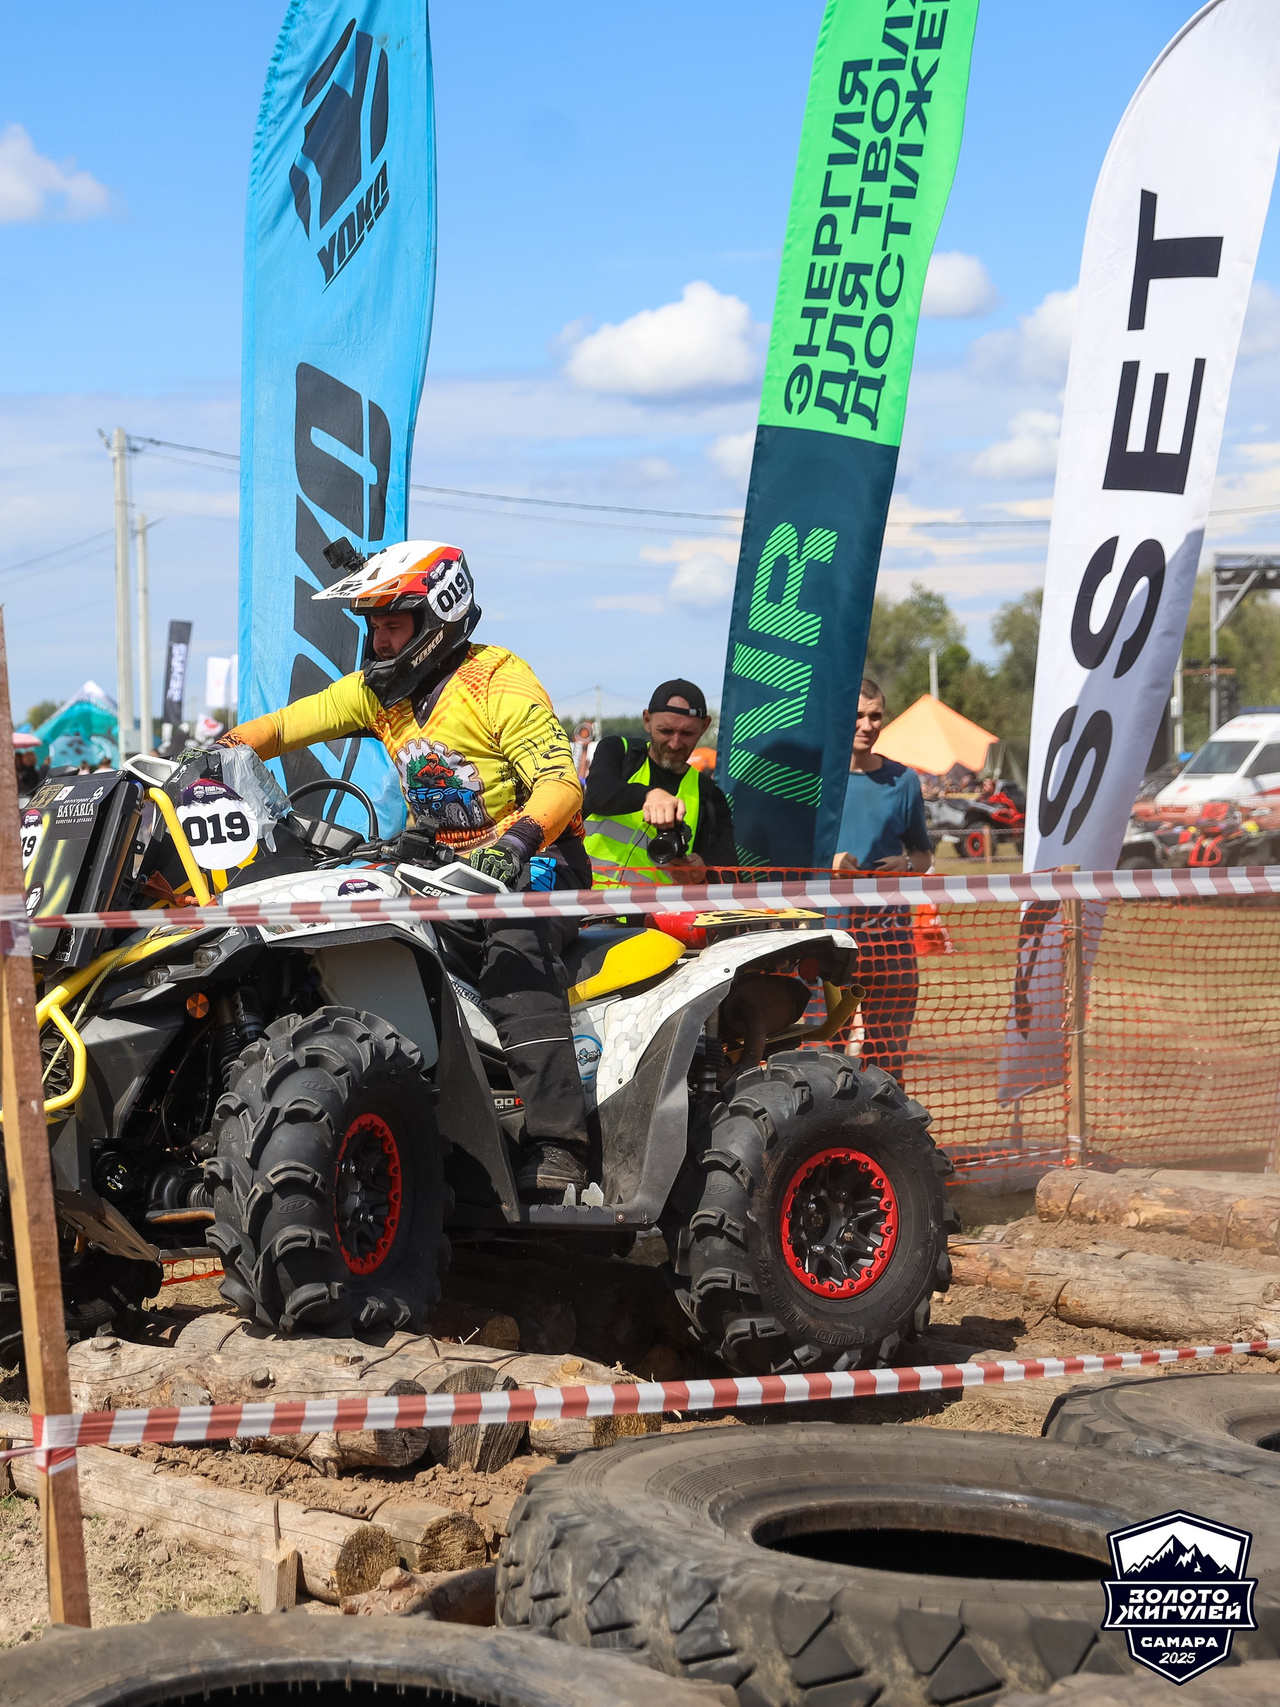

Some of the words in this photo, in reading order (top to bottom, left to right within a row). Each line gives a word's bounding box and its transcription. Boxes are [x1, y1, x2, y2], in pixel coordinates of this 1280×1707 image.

[317, 159, 390, 290] YOKO
[783, 58, 873, 417] ЭНЕРГИЯ
[813, 262, 874, 425] ДЛЯ
[850, 0, 916, 235] ТВОИ
[850, 0, 950, 431] ДОСТИЖЕ
[436, 572, 469, 613] 019
[56, 802, 94, 818] BAVARIA
[182, 811, 251, 847] 019
